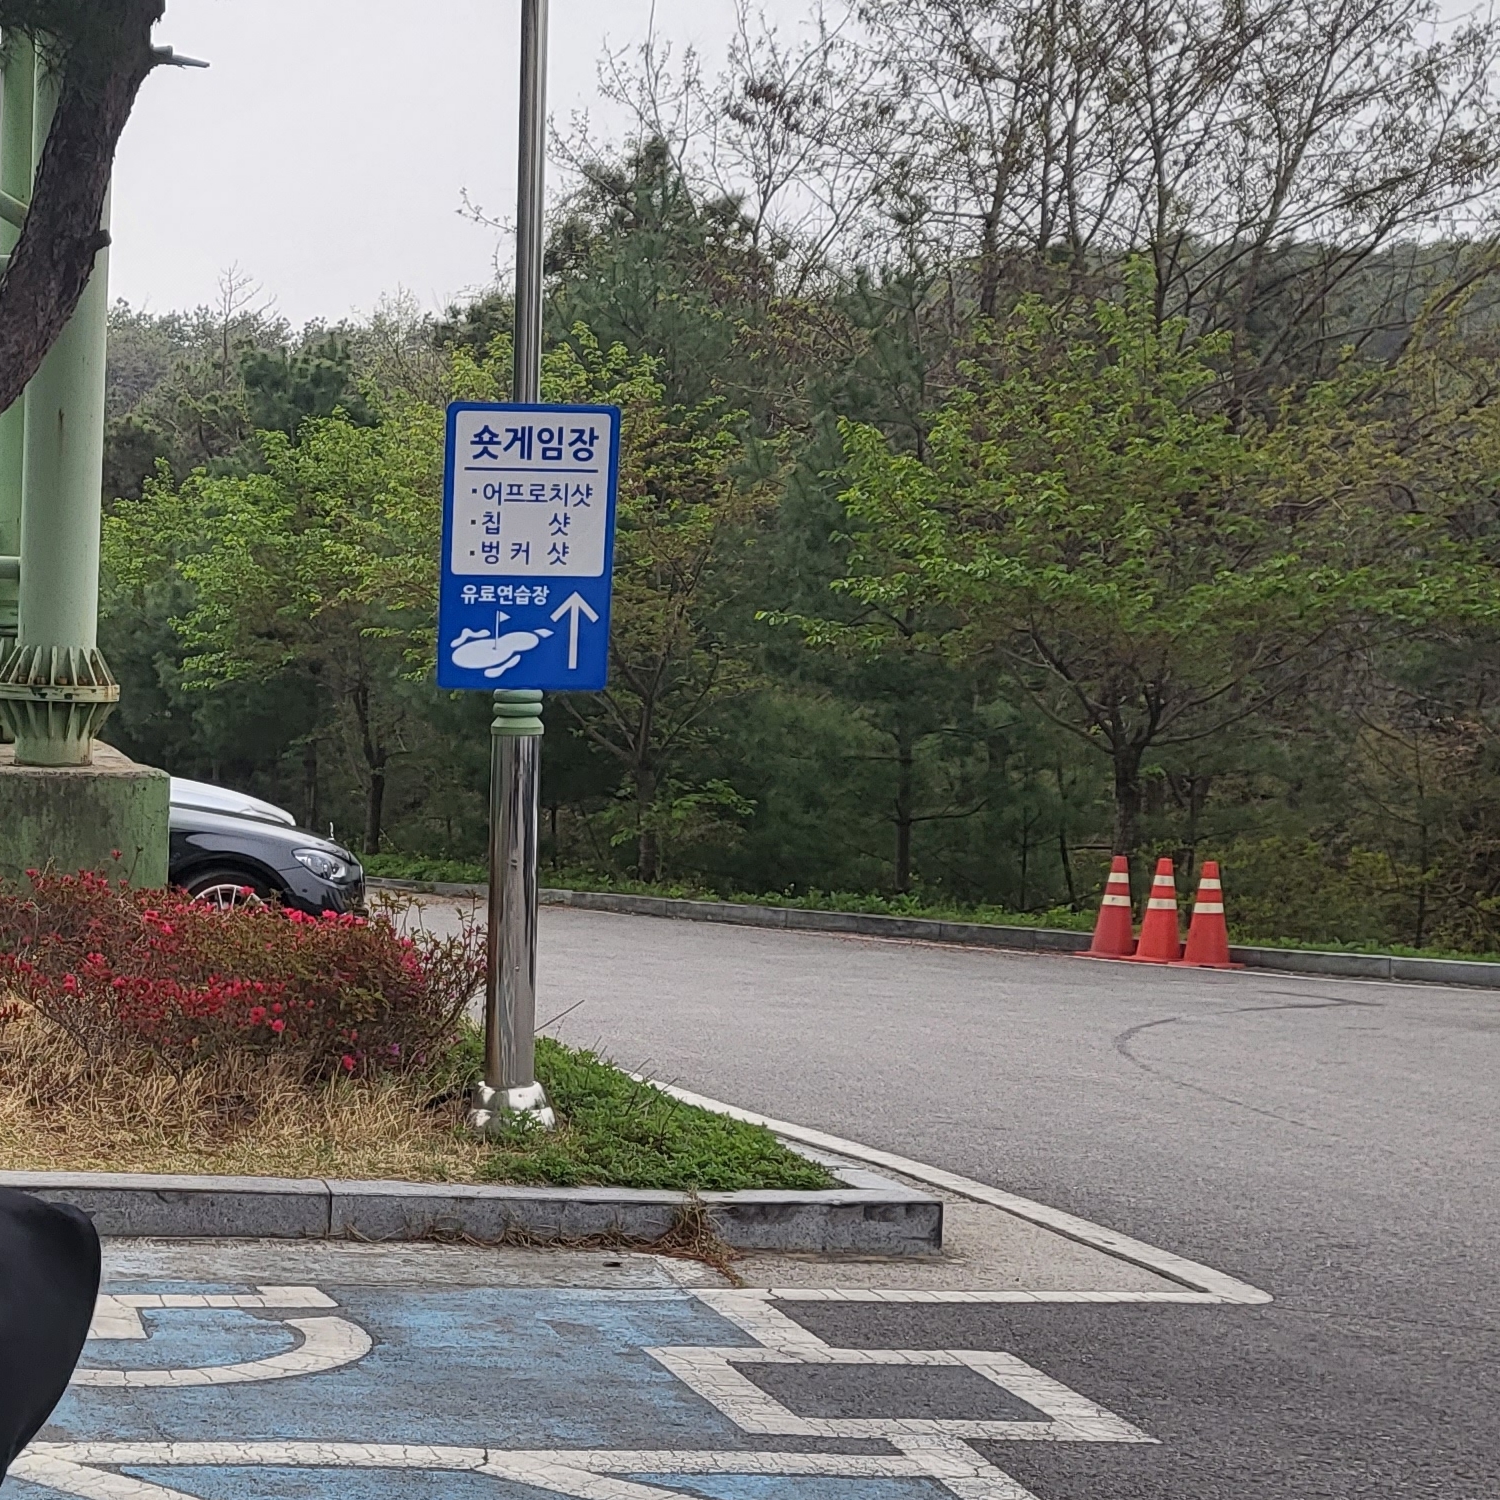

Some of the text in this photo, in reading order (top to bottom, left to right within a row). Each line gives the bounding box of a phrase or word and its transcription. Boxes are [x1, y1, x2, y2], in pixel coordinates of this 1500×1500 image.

[470, 424, 599, 462] 숏게임장
[483, 482, 593, 508] 어프로치샷
[460, 584, 550, 605] 유료연습장
